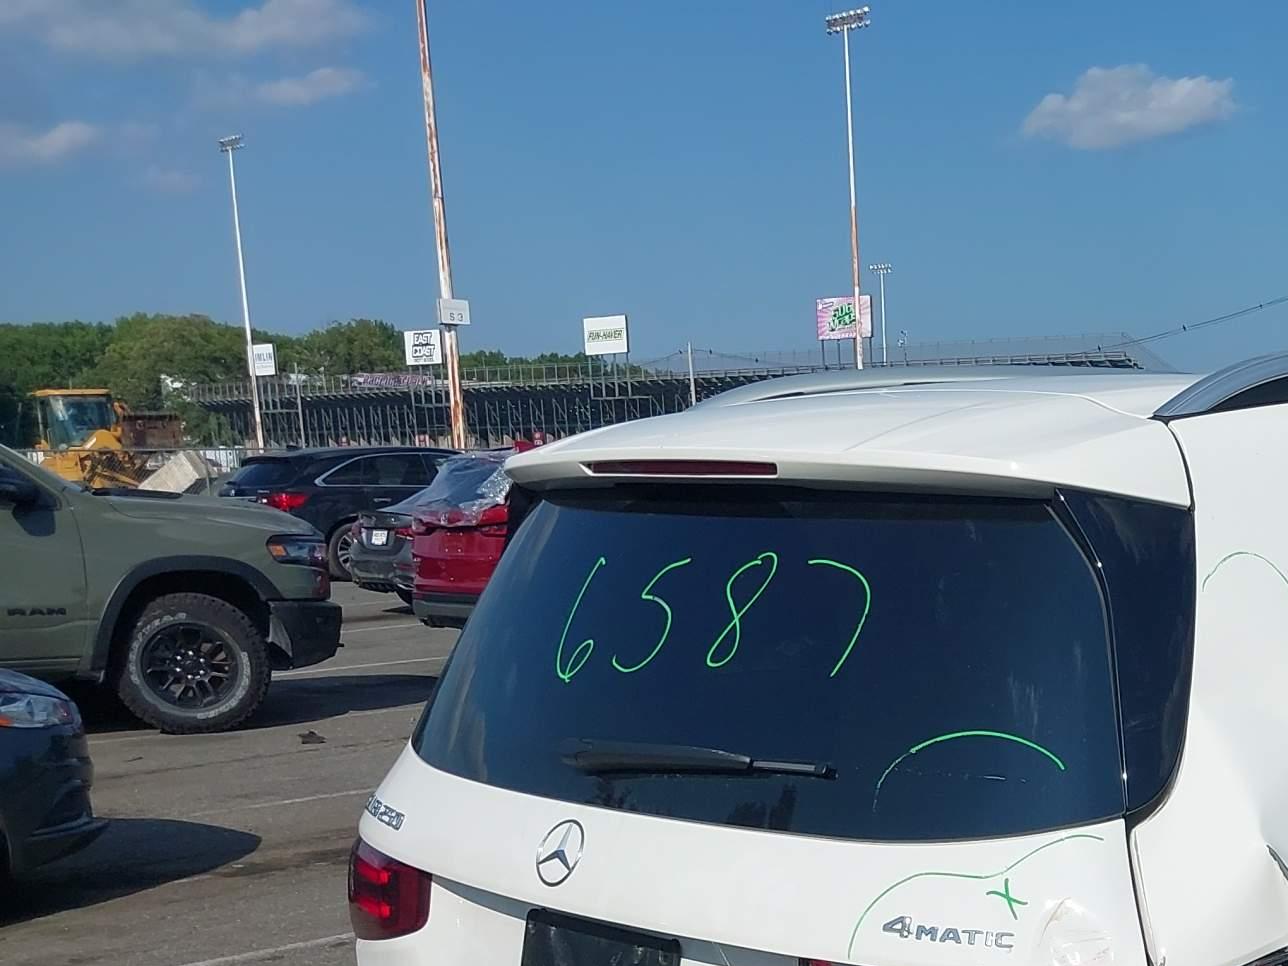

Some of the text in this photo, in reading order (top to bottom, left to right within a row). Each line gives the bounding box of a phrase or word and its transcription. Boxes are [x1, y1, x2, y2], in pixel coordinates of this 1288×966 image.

[413, 332, 433, 345] EAST
[412, 344, 436, 358] COAST
[7, 607, 67, 617] RAM
[556, 551, 871, 682] 6587
[882, 915, 1015, 949] 4MATIC
